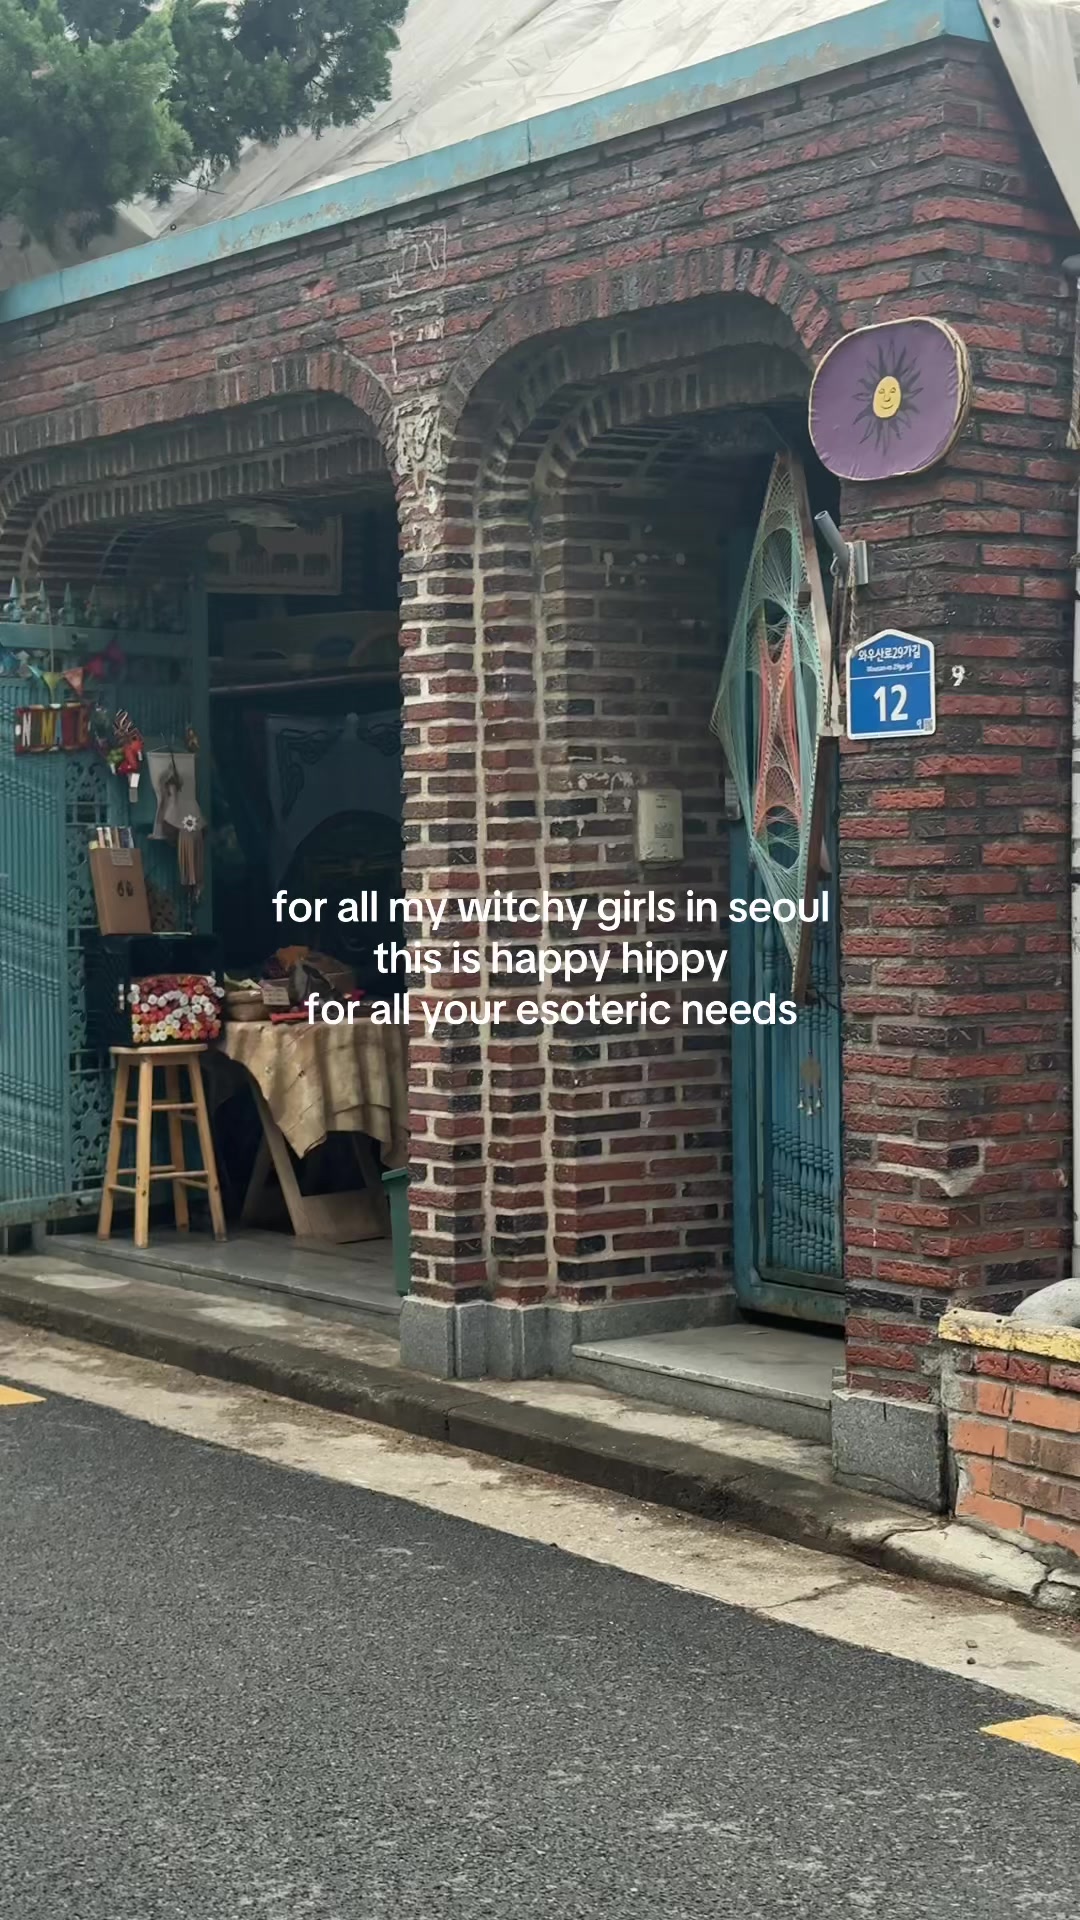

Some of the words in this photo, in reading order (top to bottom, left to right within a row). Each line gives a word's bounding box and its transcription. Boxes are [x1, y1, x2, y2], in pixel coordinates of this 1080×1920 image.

[857, 643, 921, 663] 와우산로29가길
[951, 664, 966, 687] 9
[873, 683, 908, 722] 12
